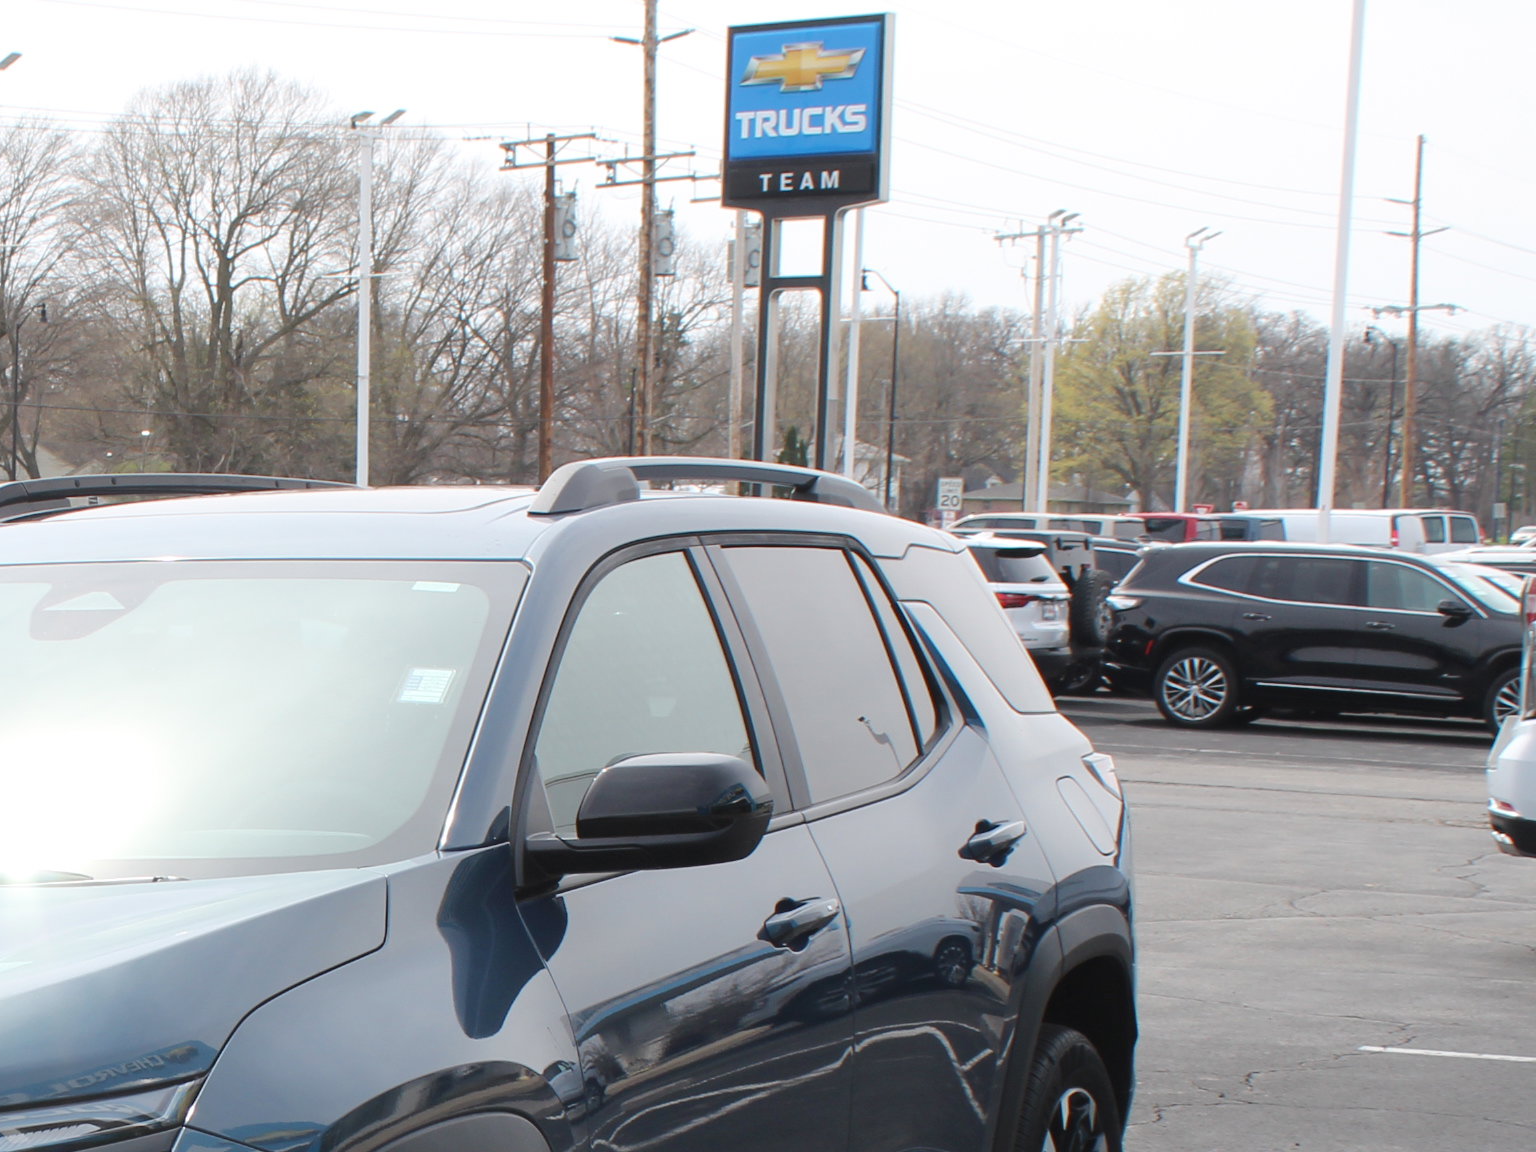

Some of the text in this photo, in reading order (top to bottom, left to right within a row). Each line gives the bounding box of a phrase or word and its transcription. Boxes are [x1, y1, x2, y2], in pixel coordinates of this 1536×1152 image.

[735, 104, 867, 139] TRUCKS
[759, 170, 840, 192] TEAM
[940, 495, 960, 507] 20
